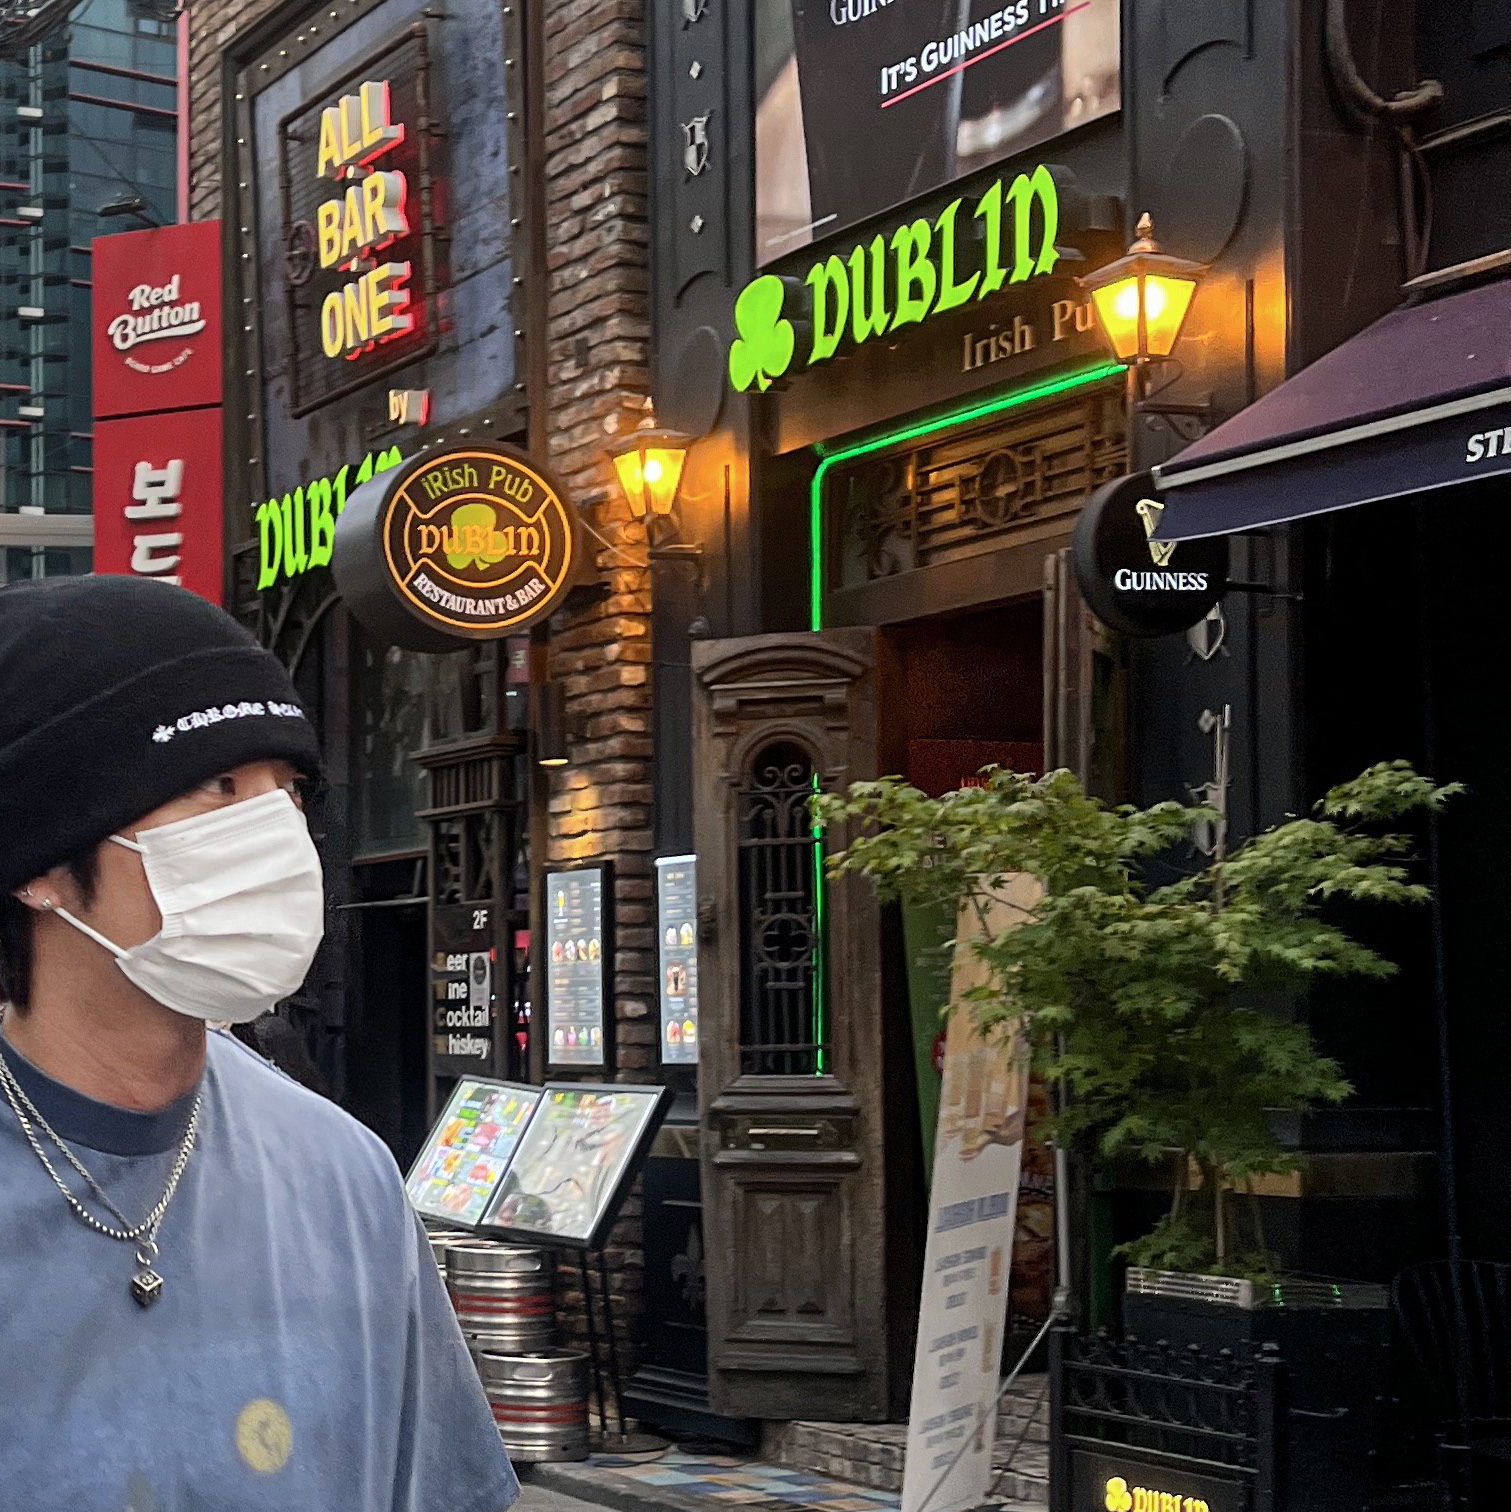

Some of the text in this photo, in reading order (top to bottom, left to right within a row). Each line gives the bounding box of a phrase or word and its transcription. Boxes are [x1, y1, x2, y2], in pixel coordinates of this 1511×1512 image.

[881, 2, 1030, 95] IT'S GUINNESS
[318, 81, 392, 178] ALL
[317, 172, 392, 269] BAR
[806, 164, 1059, 366] DUBLIN
[128, 274, 181, 311] Red
[321, 262, 396, 358] ONE
[108, 301, 207, 350] Button
[961, 298, 1096, 373] Irish Pu
[388, 388, 411, 424] by
[489, 466, 535, 503] Pub
[417, 523, 541, 557] DUBLIN
[1115, 567, 1209, 591] GUINNESS
[472, 909, 489, 931] 2F
